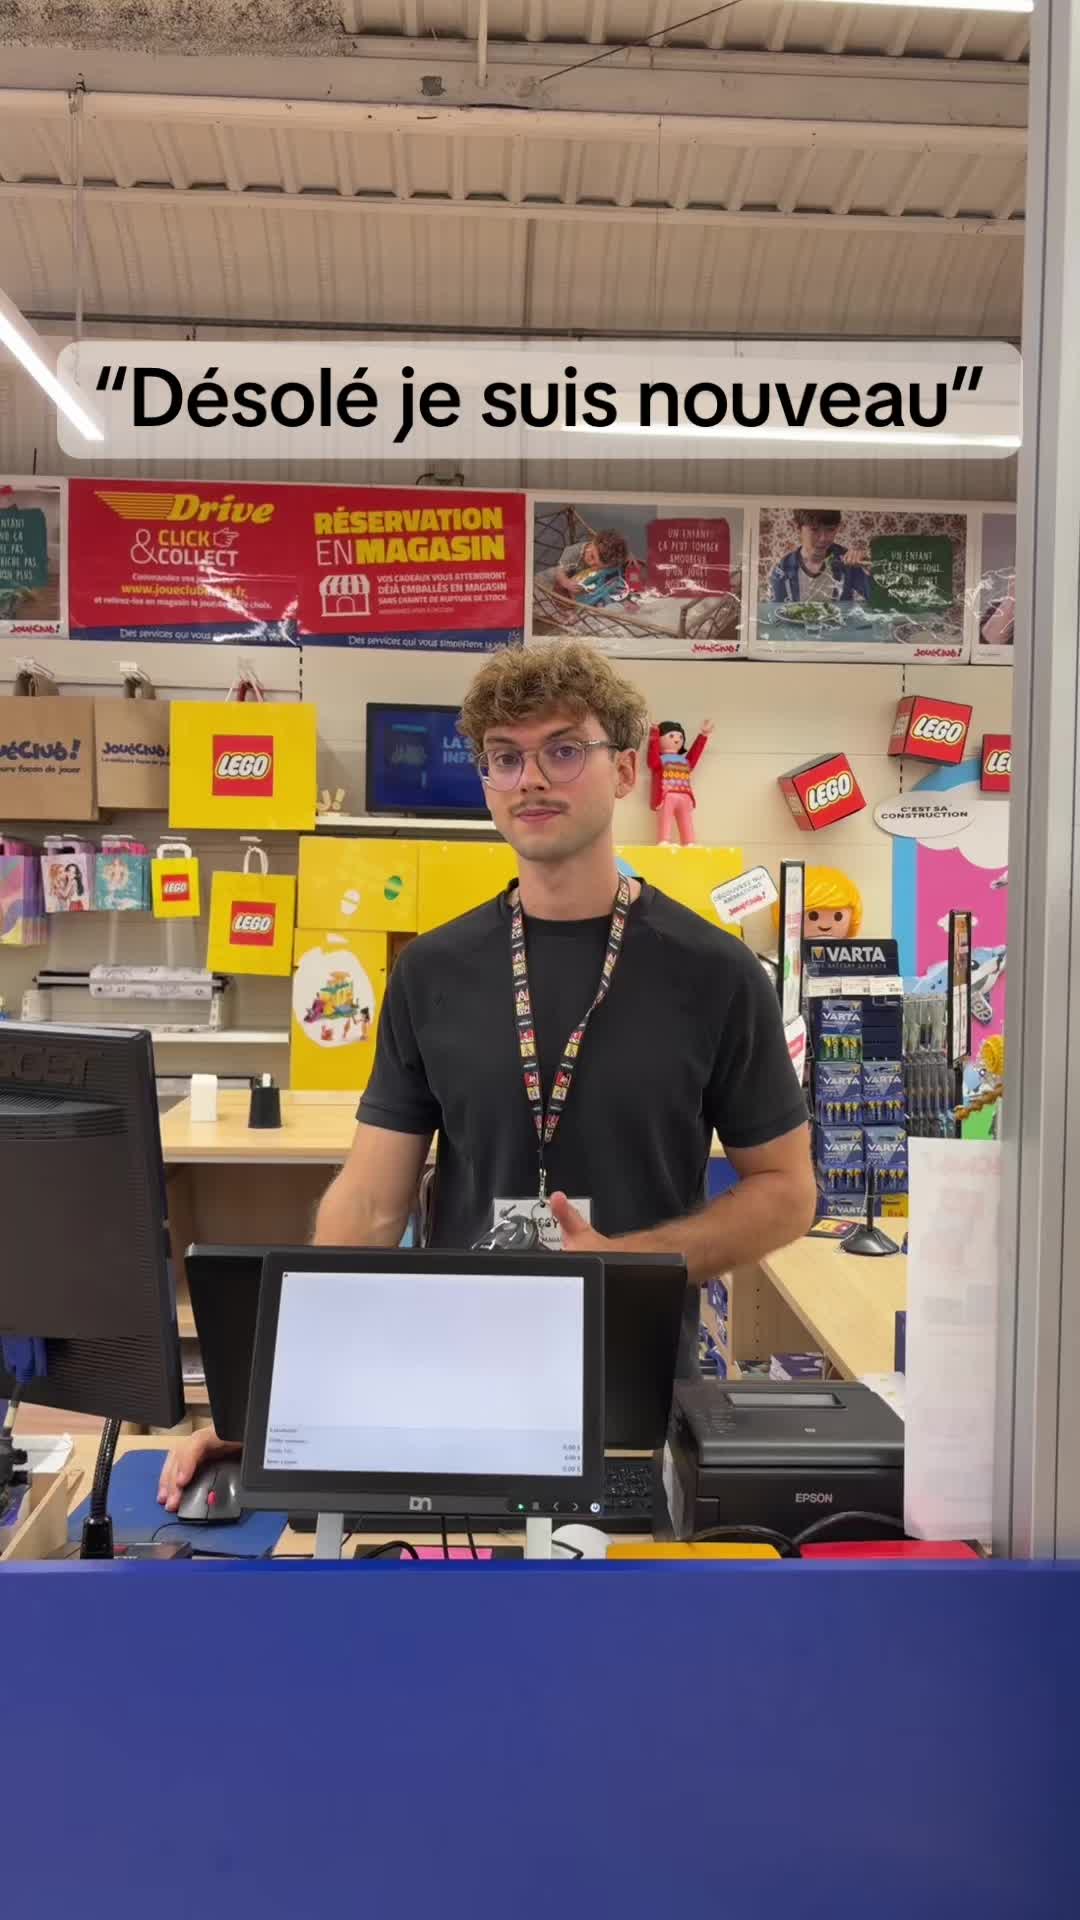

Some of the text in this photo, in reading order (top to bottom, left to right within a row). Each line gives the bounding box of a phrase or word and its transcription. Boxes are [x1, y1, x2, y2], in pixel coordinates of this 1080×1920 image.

[167, 494, 275, 523] Drive
[314, 507, 503, 535] RÉSERVATION
[130, 528, 210, 565] & CLICK
[316, 535, 505, 567] EN MAGASIN
[158, 548, 239, 566] COLLECT
[377, 571, 507, 583] VOS CADEAUX VOUS ATTENDRONT
[378, 582, 507, 595] DÉJÀ EMBALLÉS EN MAGASIN
[120, 628, 137, 638] Des
[139, 629, 174, 639] services
[175, 630, 188, 641] qui
[190, 631, 211, 640] vous
[349, 636, 365, 645] Des
[367, 636, 401, 646] services
[403, 637, 417, 648] qui
[418, 638, 438, 647] vous
[914, 715, 965, 744] LEGO
[216, 753, 271, 778] LEGO
[806, 773, 852, 811] LEGO
[881, 811, 968, 820] CONSTRUCTION
[163, 881, 188, 895] LEGO
[232, 912, 273, 933] LEGO
[826, 946, 886, 962] VARTA
[822, 1012, 861, 1022] VARTA
[823, 1077, 860, 1085] VARTA
[864, 1075, 902, 1084] VARTA
[824, 1143, 863, 1152] VARTA
[867, 1143, 905, 1152] VARTA
[795, 1493, 833, 1503] EPSON
